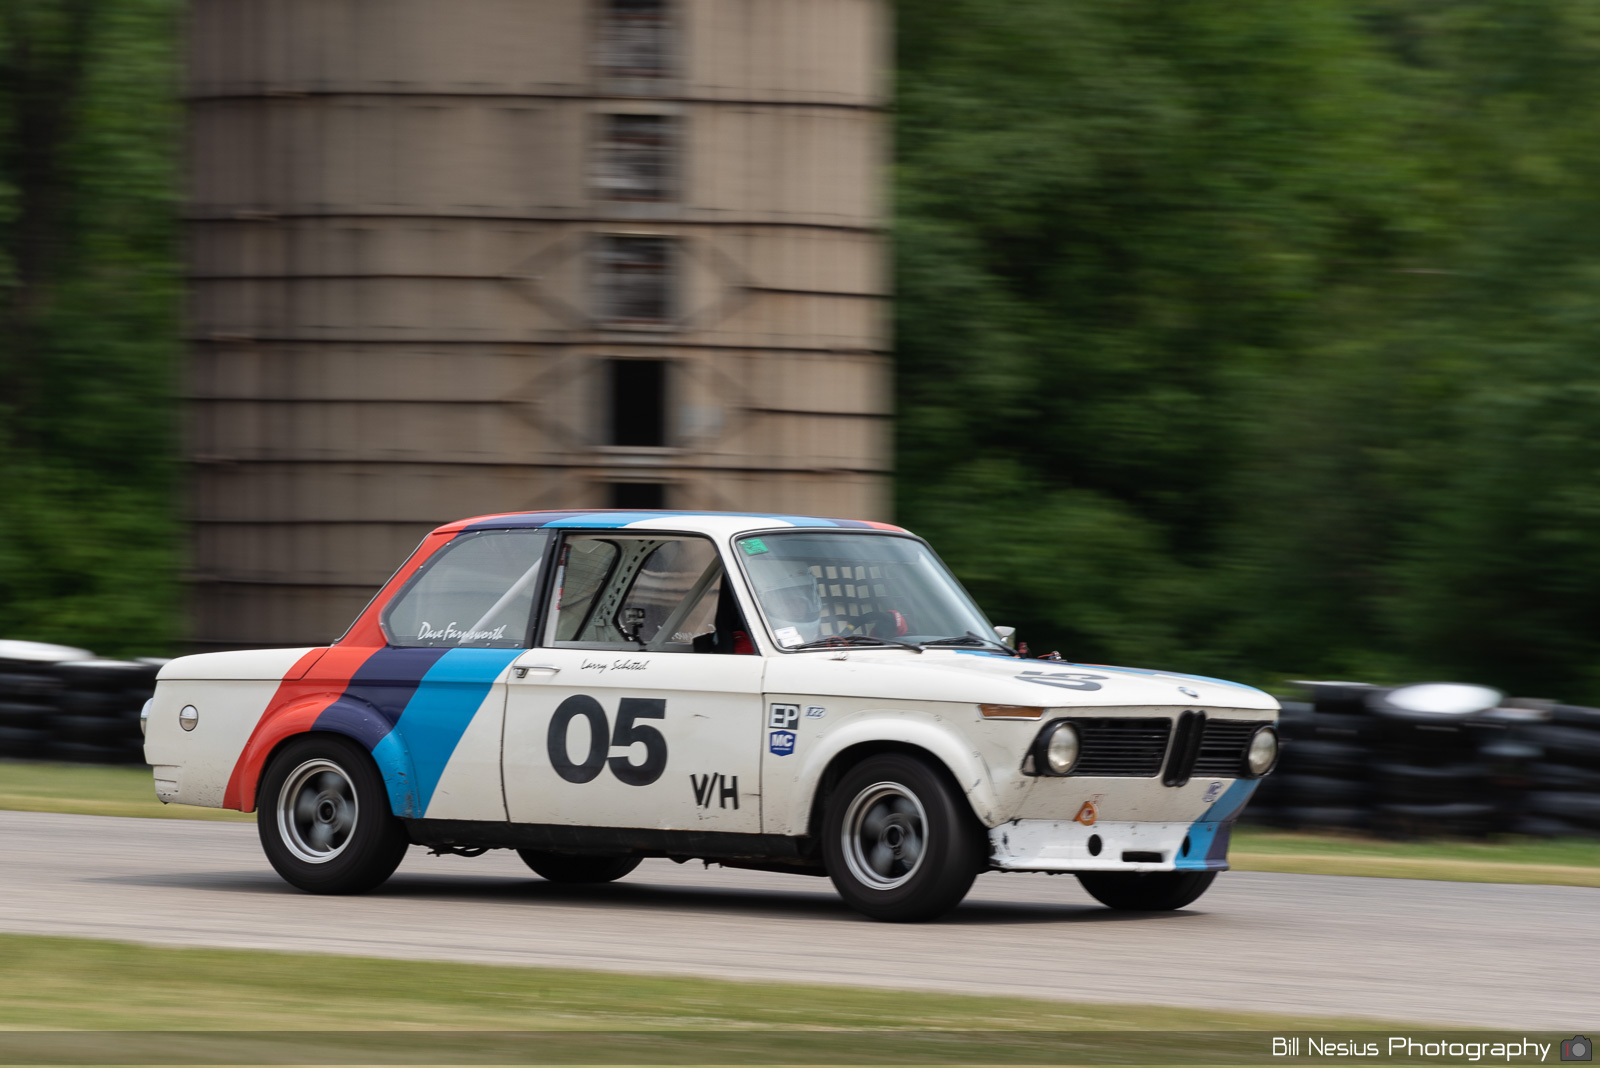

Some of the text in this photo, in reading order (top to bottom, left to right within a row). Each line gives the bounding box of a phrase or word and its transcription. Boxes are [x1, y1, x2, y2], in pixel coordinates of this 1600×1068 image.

[417, 621, 444, 640] Dave
[770, 704, 799, 728] EP
[547, 694, 668, 787] 05
[771, 734, 794, 747] MC
